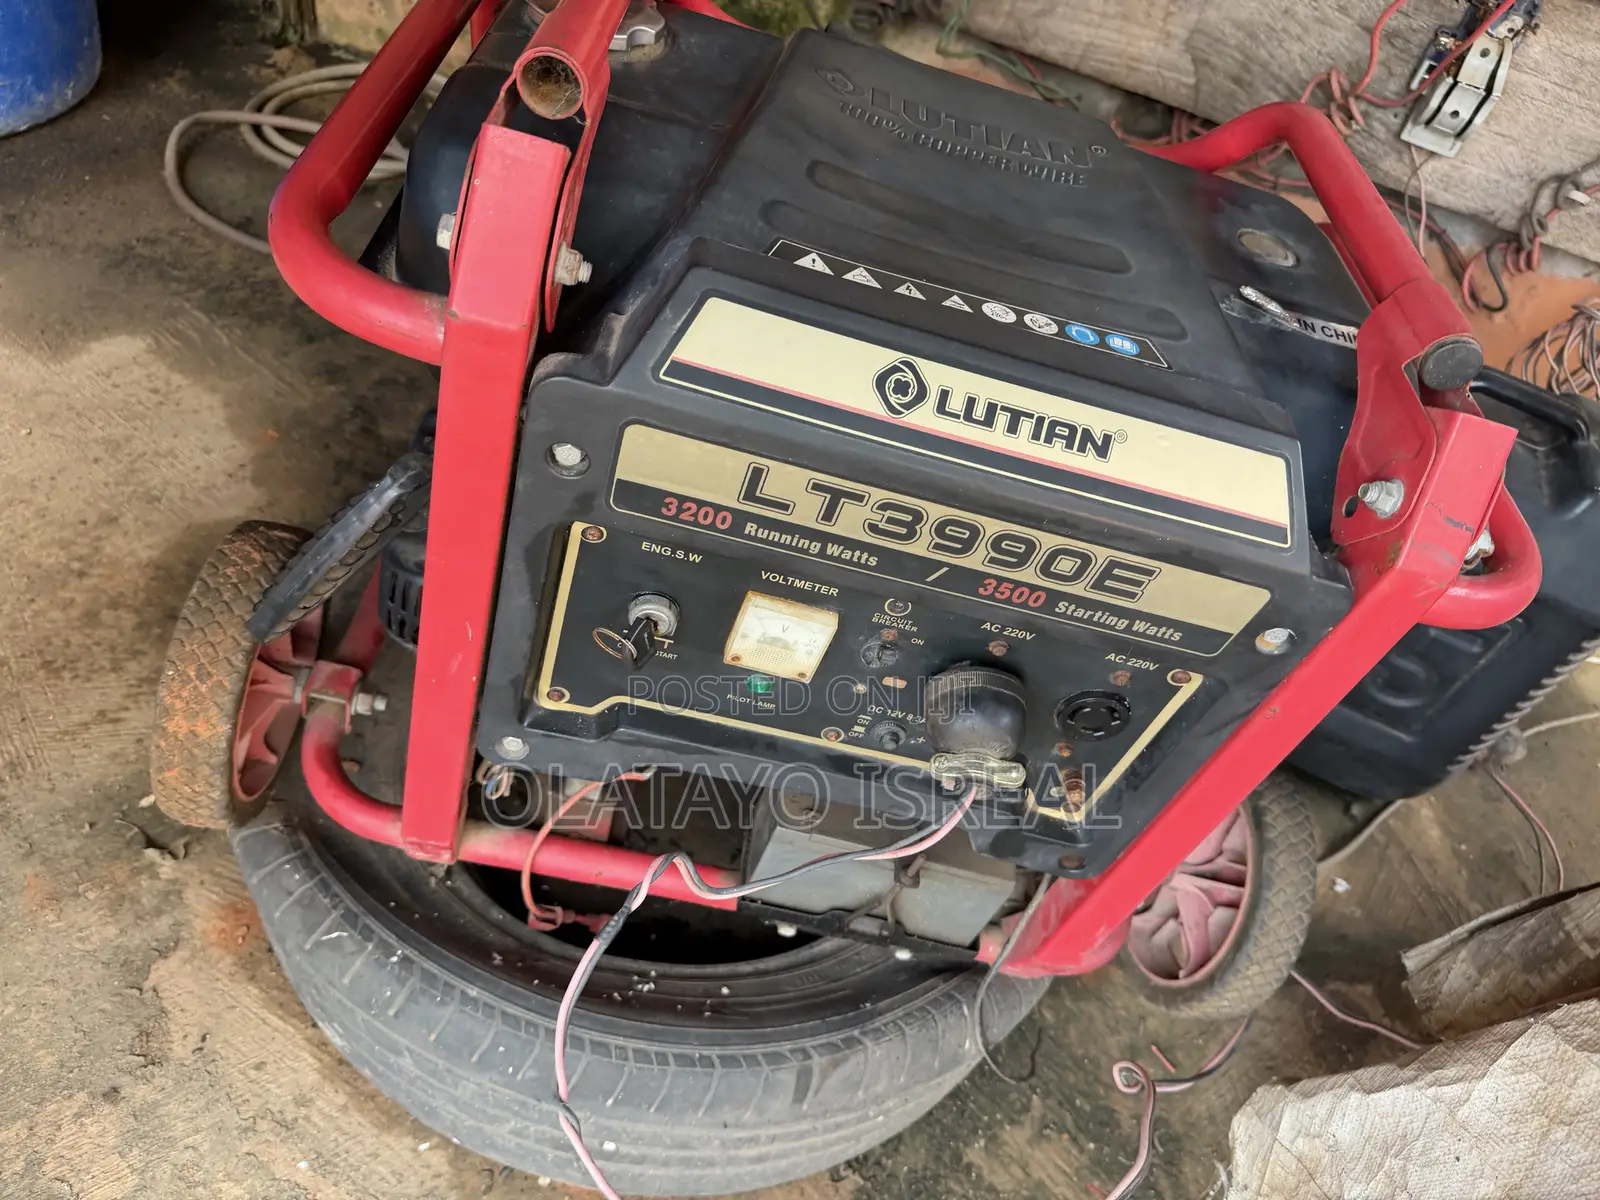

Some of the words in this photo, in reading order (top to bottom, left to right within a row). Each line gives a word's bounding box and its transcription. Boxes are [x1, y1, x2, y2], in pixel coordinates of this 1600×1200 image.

[869, 87, 1094, 169] LUTIAN
[933, 385, 1115, 463] LUTIAN
[737, 462, 1162, 604] LT3990E
[641, 541, 703, 564] ENG.S.W
[661, 497, 733, 530] 3200
[744, 521, 822, 554] Running
[825, 542, 879, 566] Watts
[978, 578, 1047, 608] 3500
[1054, 601, 1129, 631] Starting
[1131, 619, 1183, 642] Watts
[760, 570, 839, 597] VOLTMETER
[871, 617, 918, 632] BREAKER
[874, 612, 914, 626] CIRCUIT
[980, 621, 1002, 634] AC
[1003, 626, 1036, 641] 220V
[910, 637, 925, 646] ON
[1104, 652, 1126, 664] AC
[1126, 657, 1160, 671] 220V
[726, 693, 752, 704] PILOT
[752, 699, 776, 709] LAMP
[867, 704, 884, 714] DC
[887, 709, 906, 718] 12V
